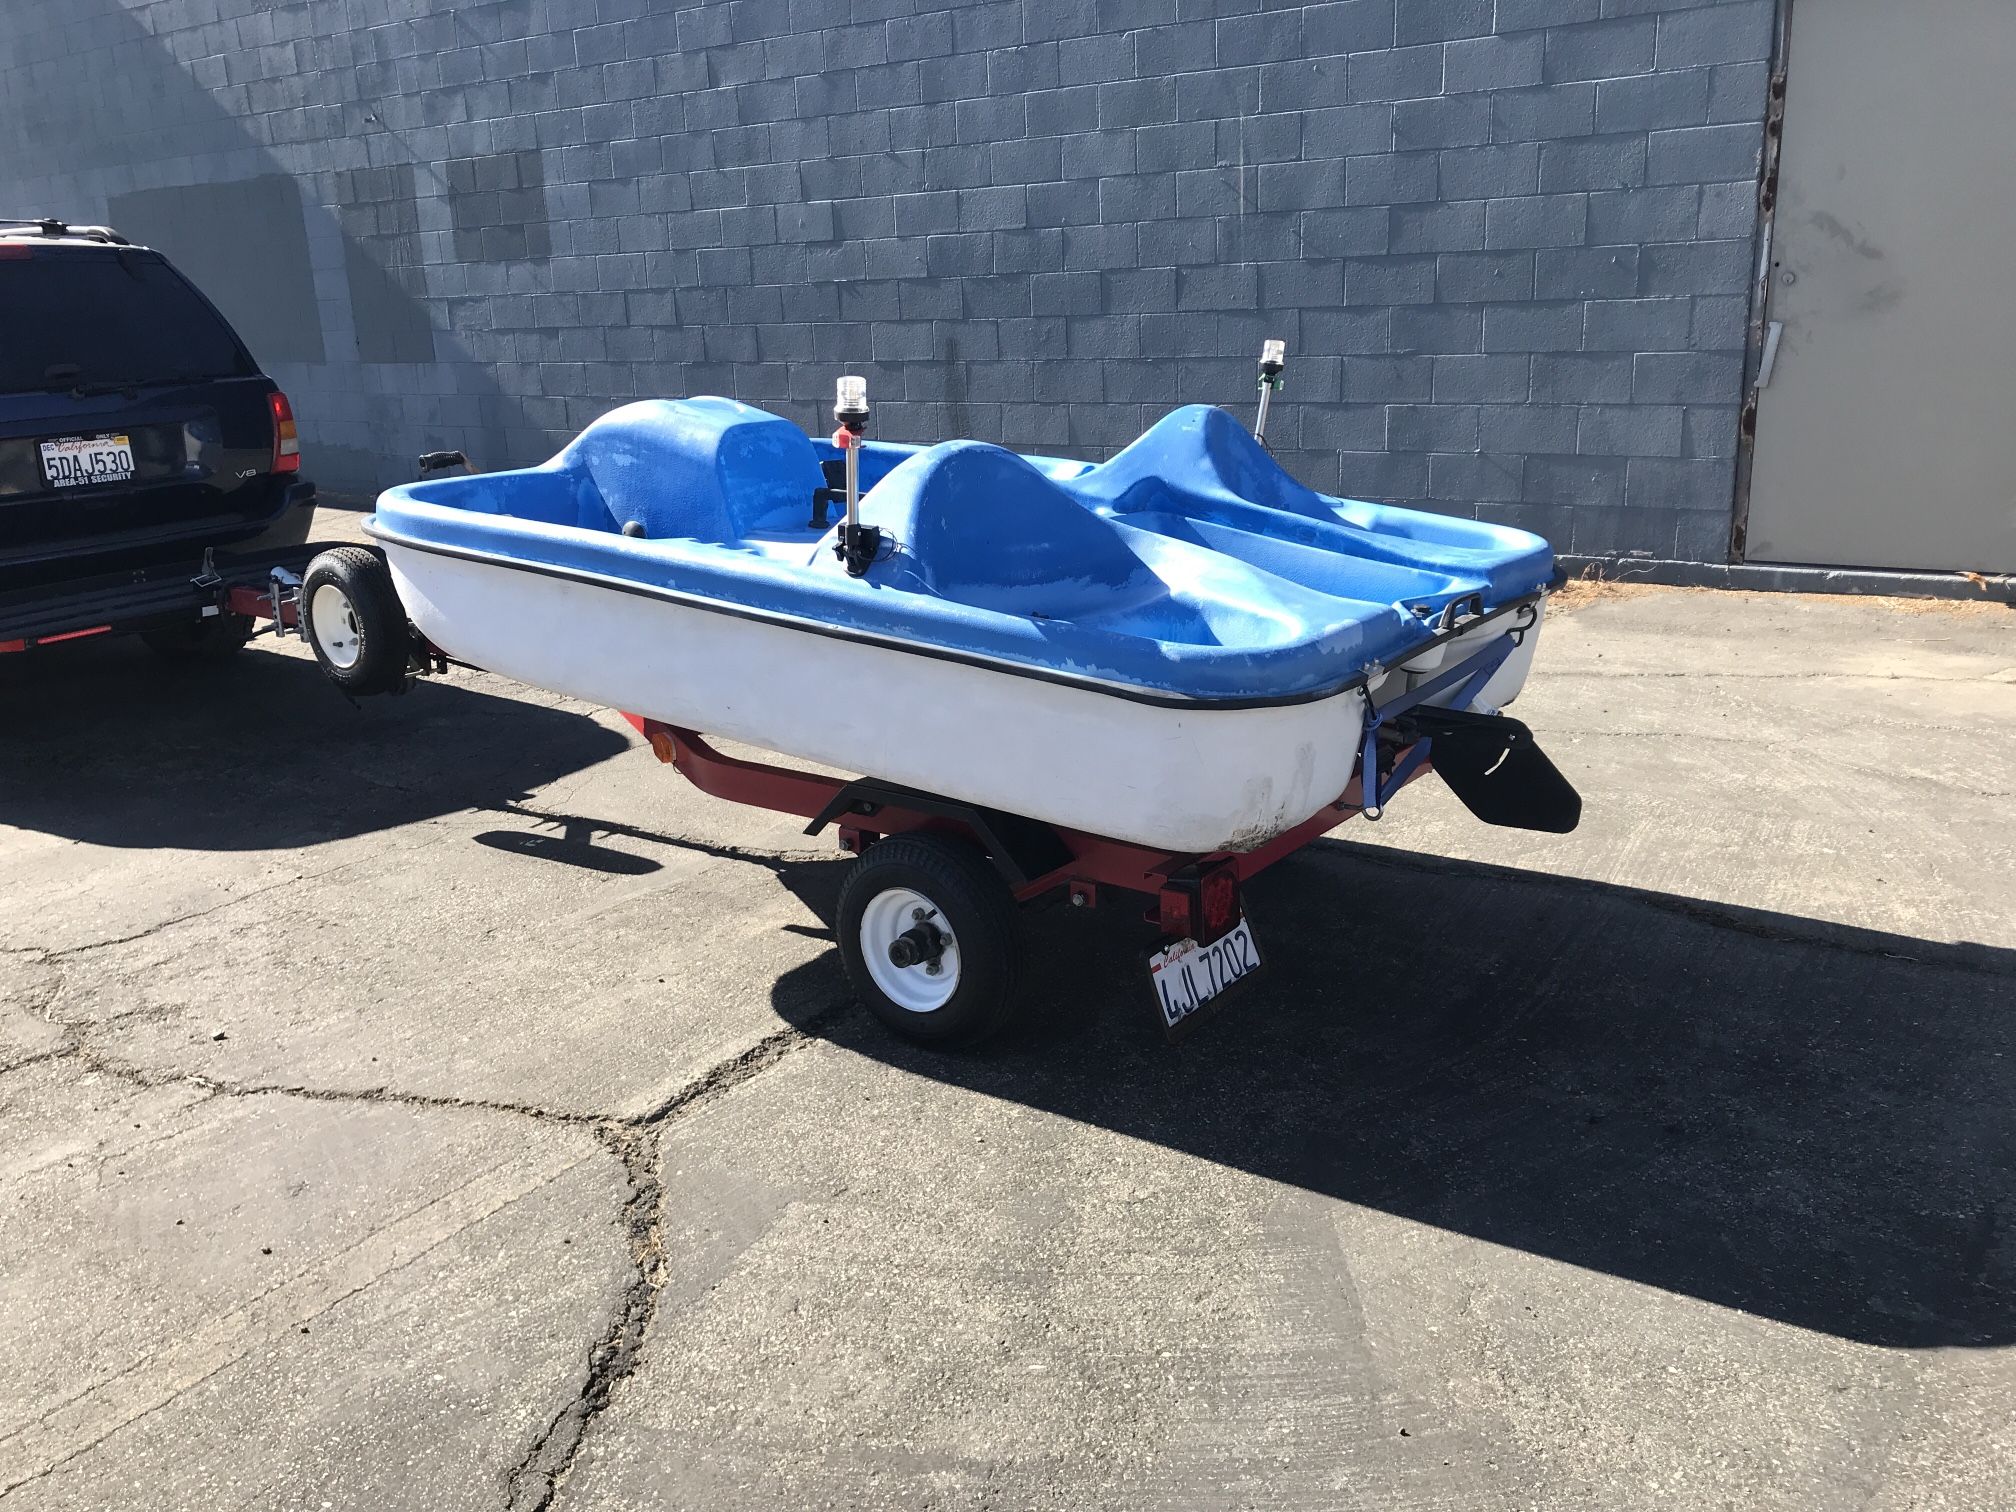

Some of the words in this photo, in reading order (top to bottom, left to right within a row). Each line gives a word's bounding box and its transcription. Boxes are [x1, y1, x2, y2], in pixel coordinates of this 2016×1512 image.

[42, 444, 55, 452] DEC
[57, 441, 112, 453] California
[46, 450, 131, 479] 5DAJ530
[53, 477, 89, 488] AREA-51
[91, 471, 132, 484] SECURITY
[235, 468, 257, 479] V8
